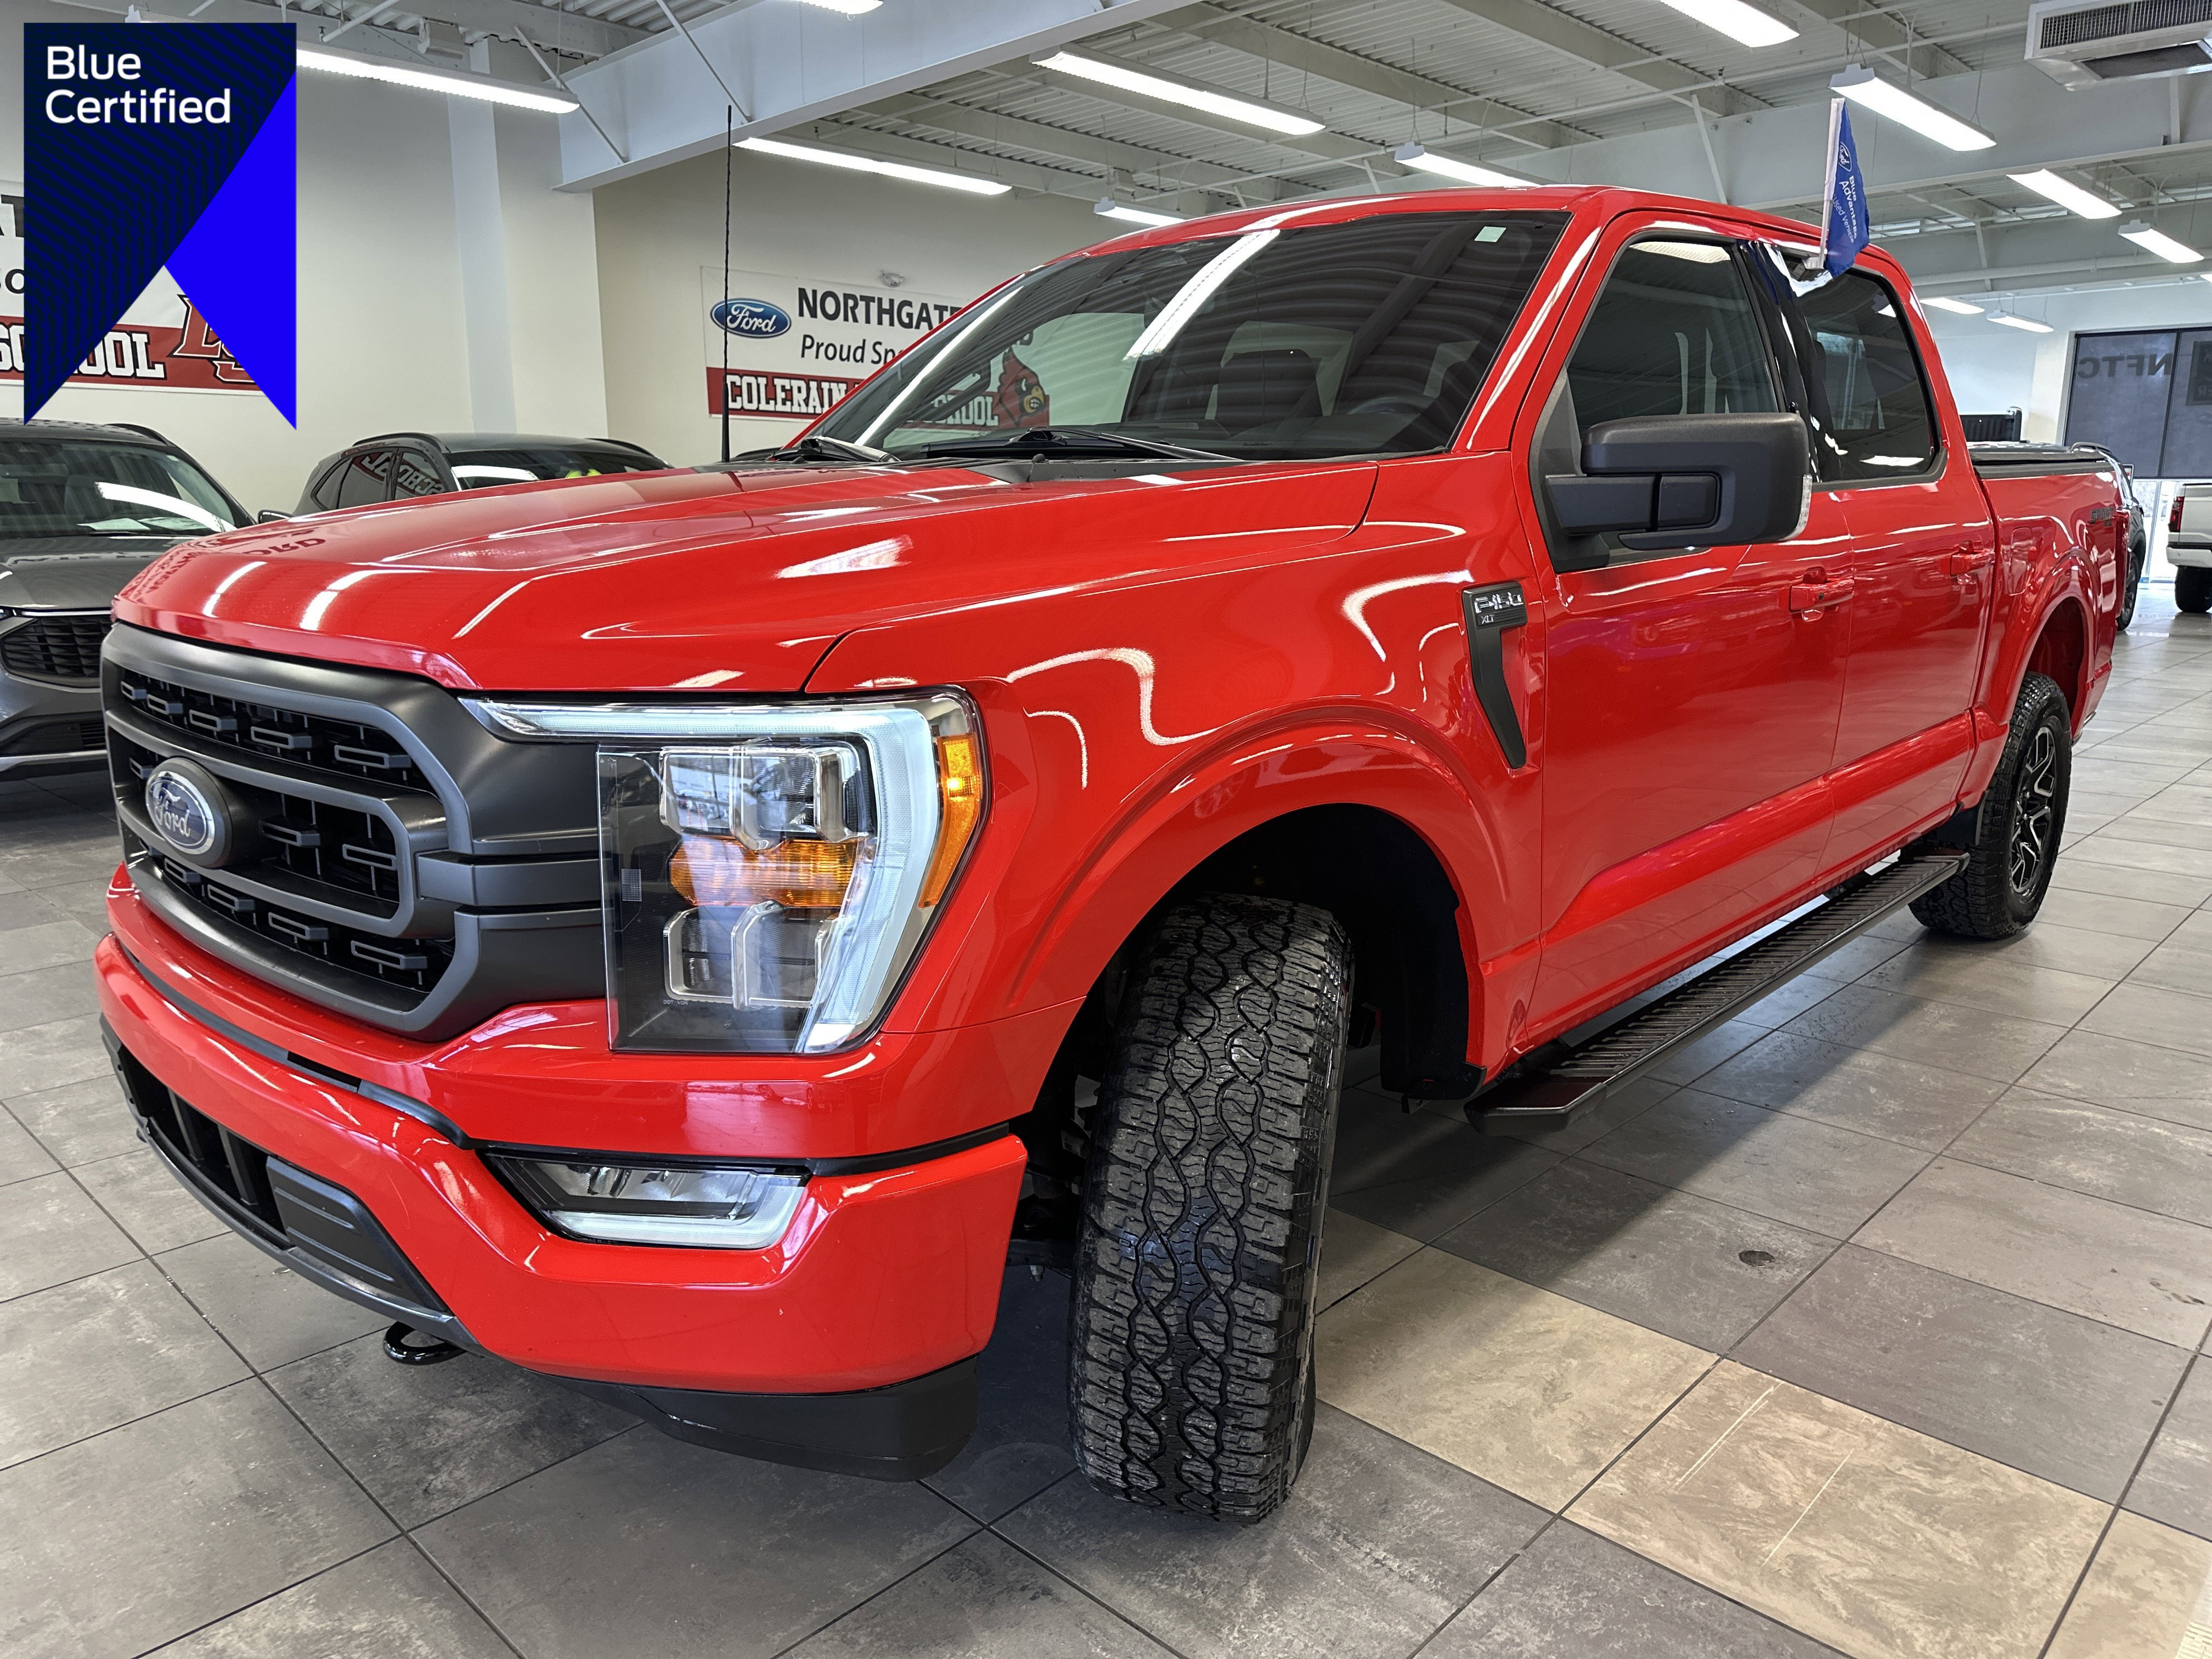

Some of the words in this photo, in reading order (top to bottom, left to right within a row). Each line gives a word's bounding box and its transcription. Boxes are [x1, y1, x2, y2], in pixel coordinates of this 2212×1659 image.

[1849, 175, 1857, 201] Blue
[1833, 196, 1846, 216] Used
[1839, 180, 1858, 240] Advantage
[726, 303, 777, 332] Ford
[801, 334, 866, 364] Proud
[724, 374, 848, 414] COLERAIN
[1481, 614, 1496, 624] XLT
[154, 786, 191, 837] Ford
